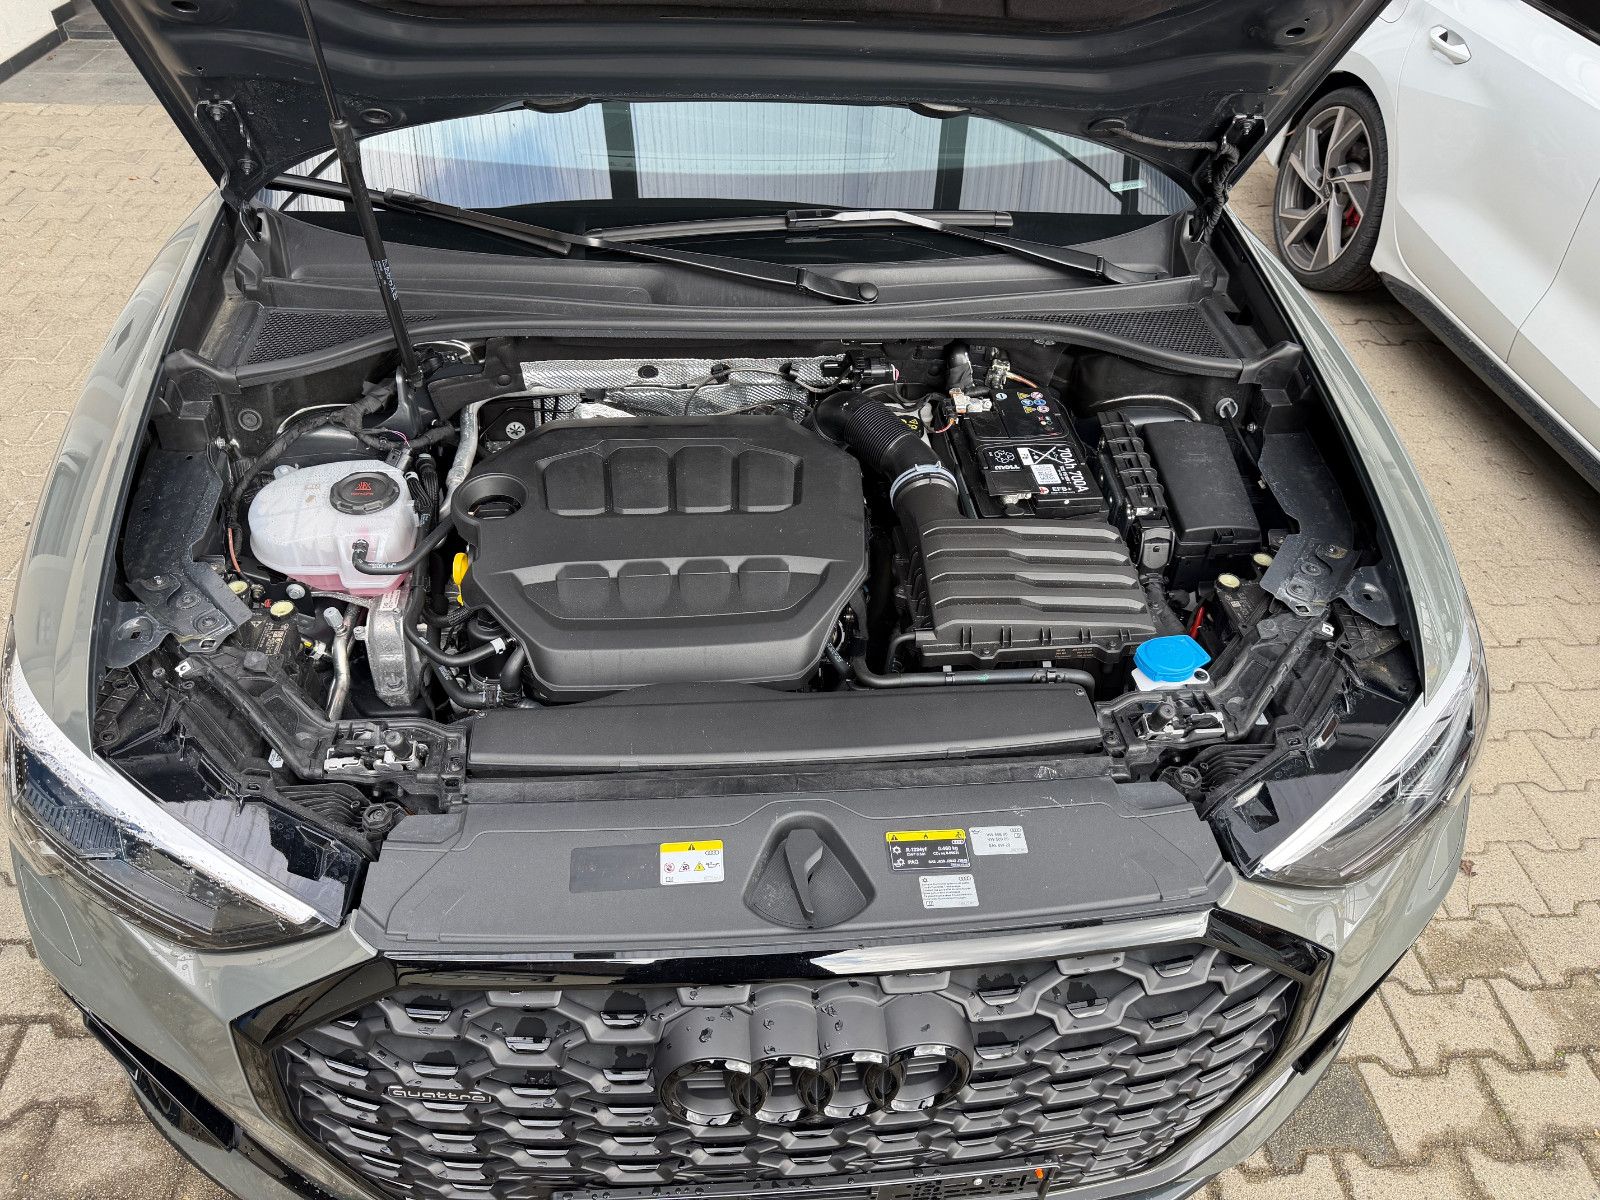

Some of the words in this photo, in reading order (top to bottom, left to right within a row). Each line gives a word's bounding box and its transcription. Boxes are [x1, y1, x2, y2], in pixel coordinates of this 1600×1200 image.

[1057, 447, 1077, 470] 70Ah
[1069, 470, 1089, 493] 700A
[392, 1089, 486, 1101] quattro
